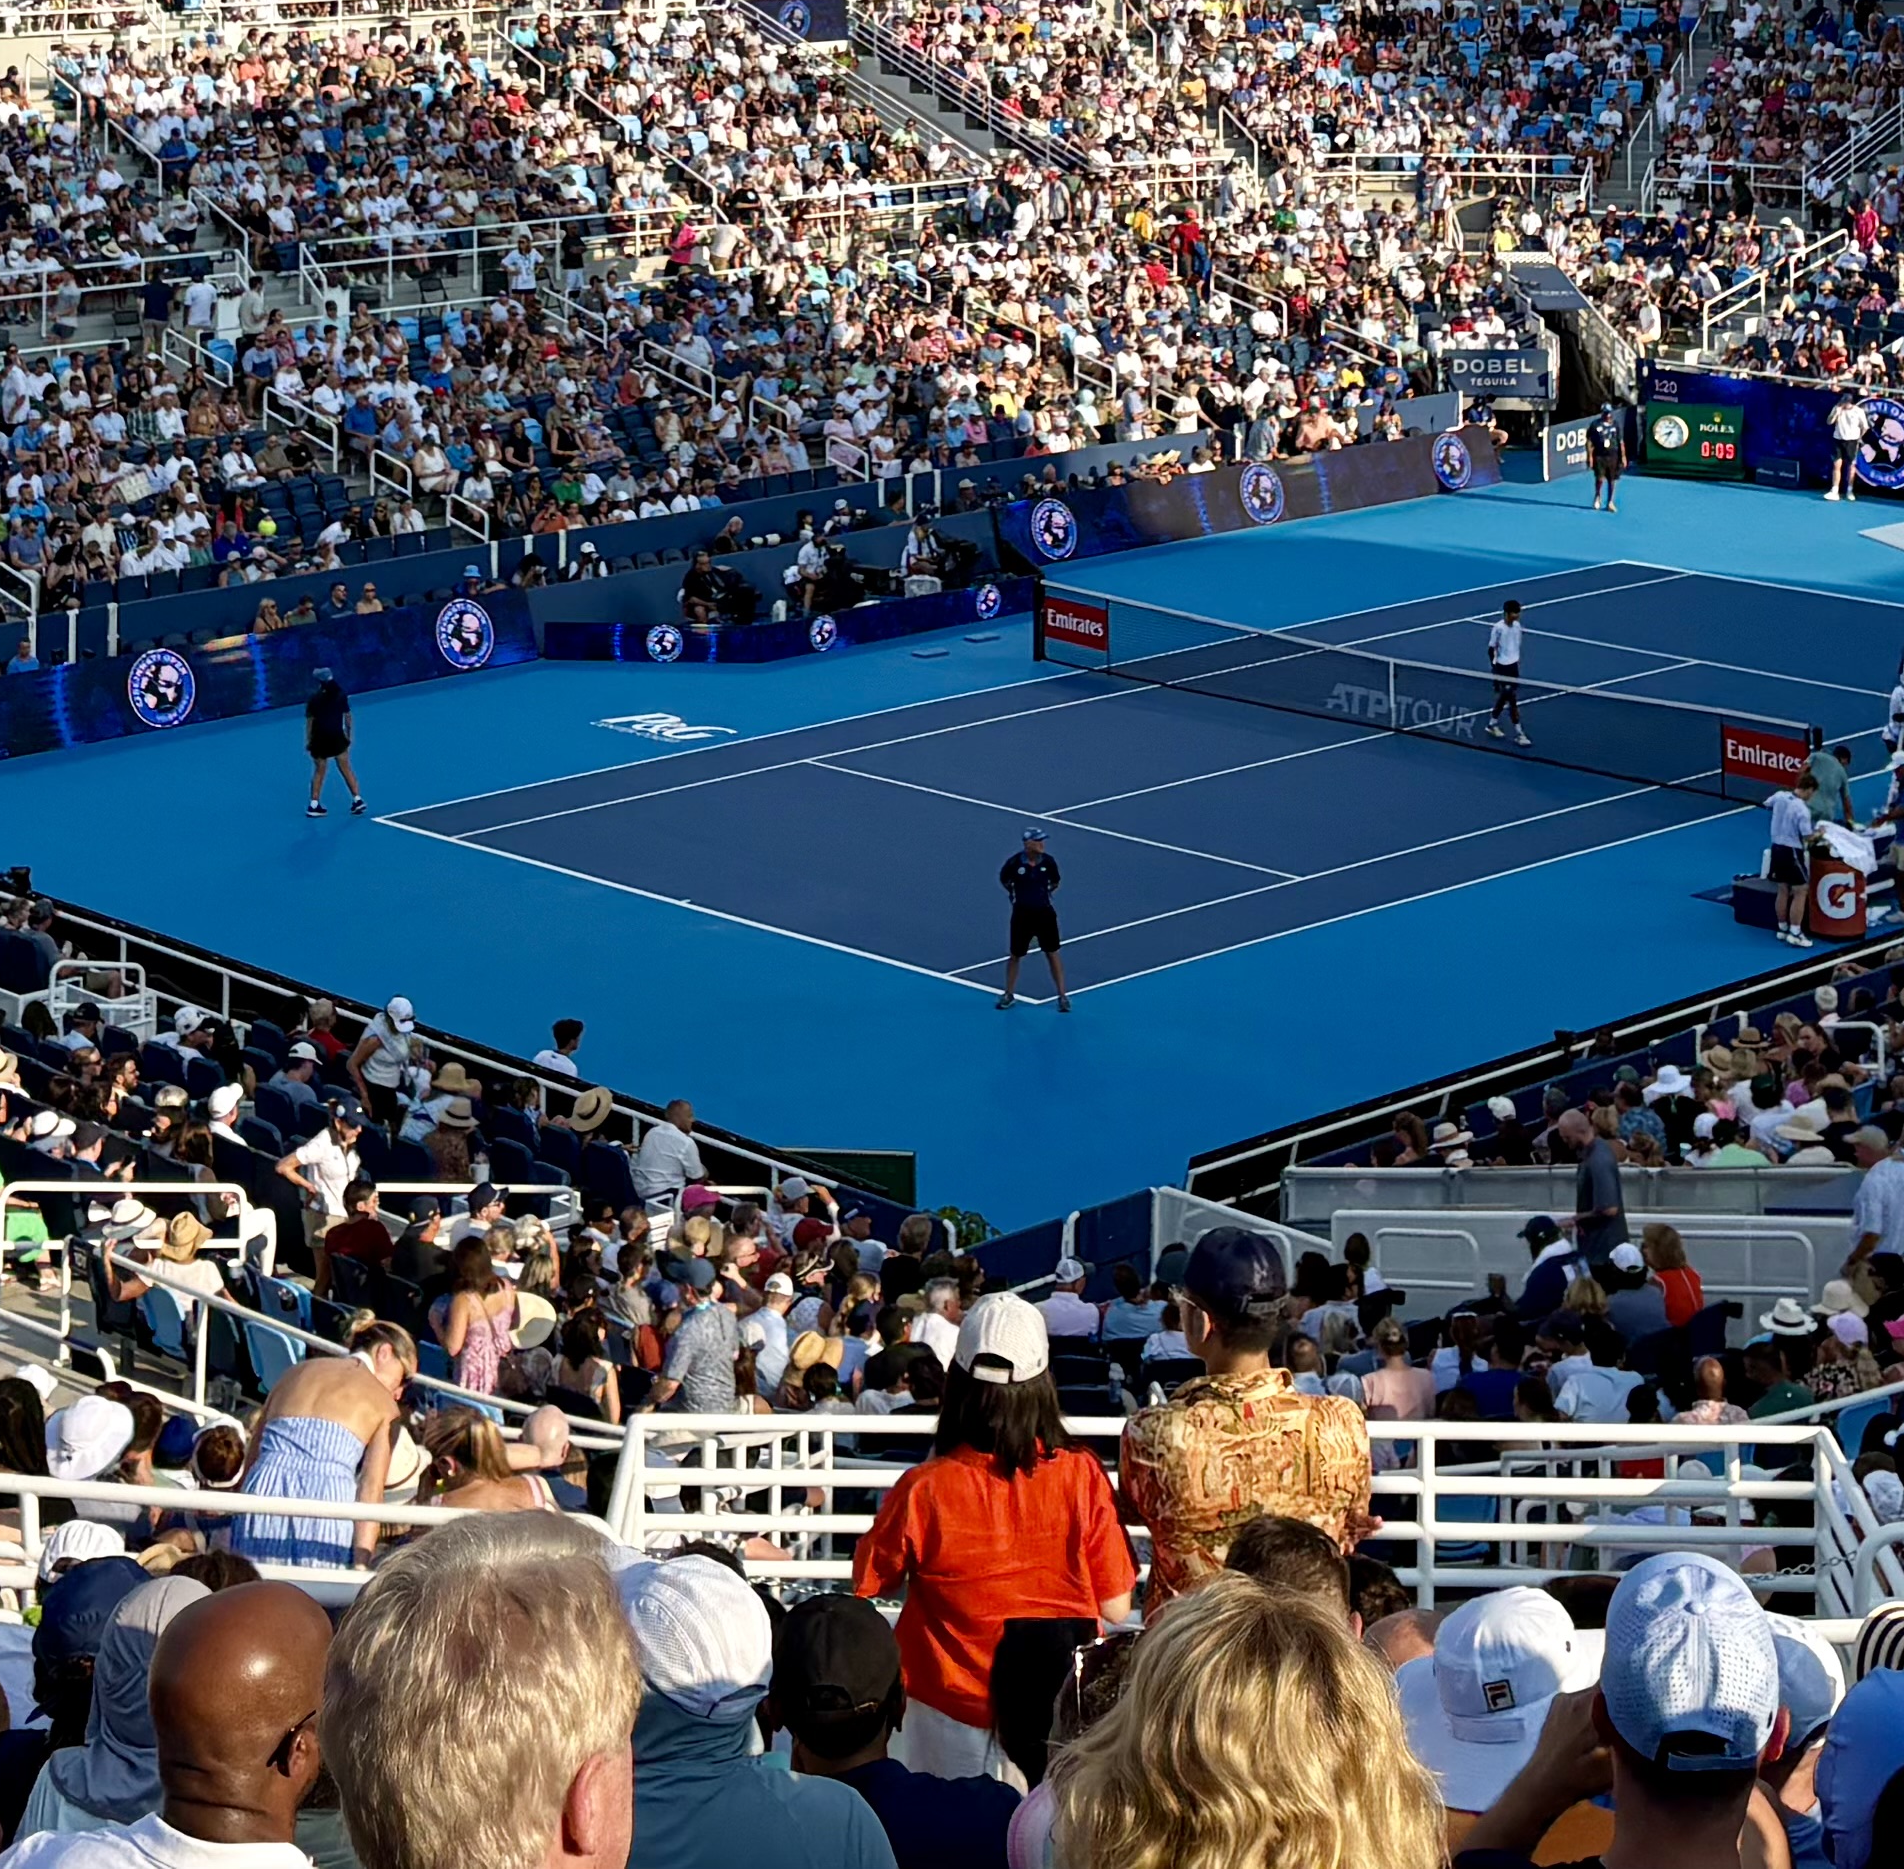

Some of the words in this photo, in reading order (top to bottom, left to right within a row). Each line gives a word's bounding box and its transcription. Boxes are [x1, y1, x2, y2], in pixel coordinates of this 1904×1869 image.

[1453, 358, 1534, 374] DOBEL
[1470, 377, 1517, 387] TEQUILA
[1699, 423, 1735, 434] ROLEX
[1047, 608, 1104, 637] Emirates
[1325, 682, 1389, 719] ATP
[1396, 695, 1476, 739] TOUR
[599, 712, 738, 740] P&G
[1816, 872, 1856, 919] G
